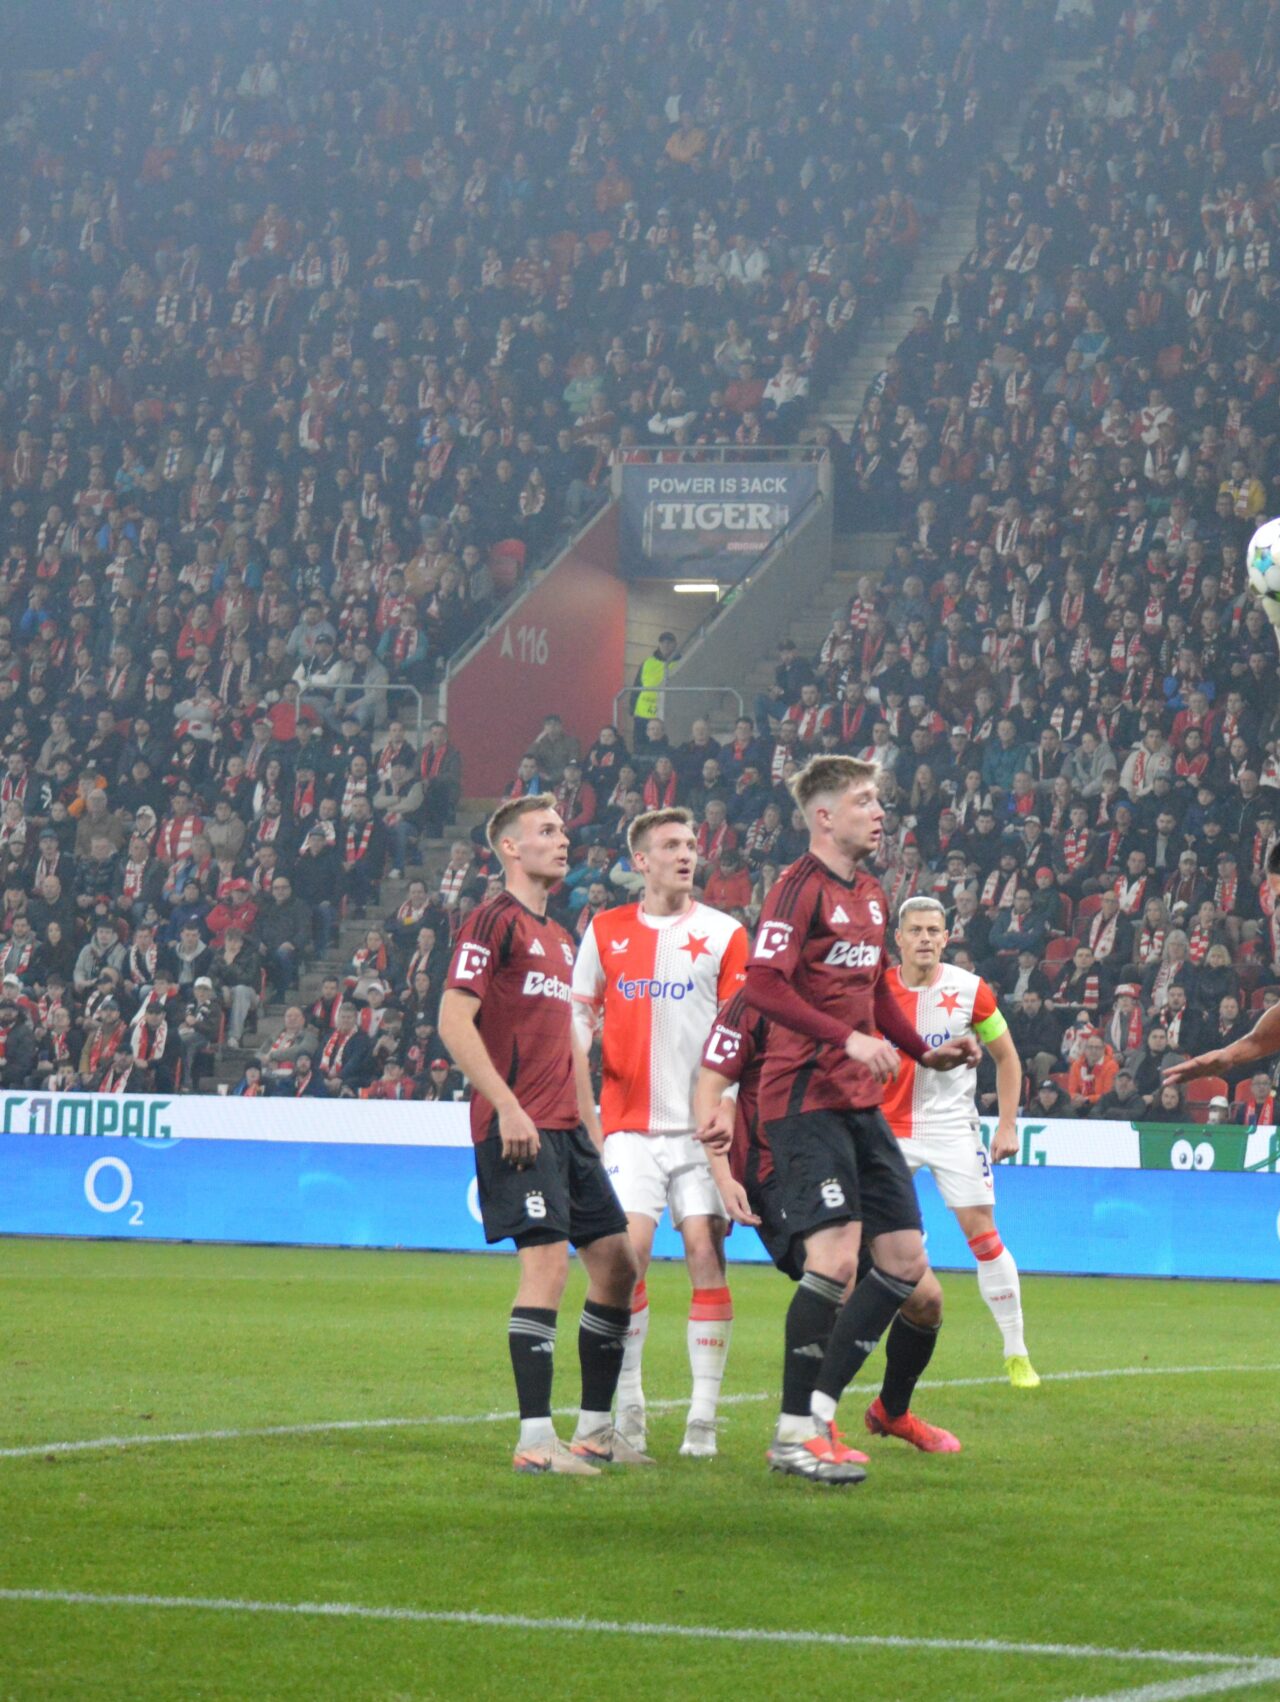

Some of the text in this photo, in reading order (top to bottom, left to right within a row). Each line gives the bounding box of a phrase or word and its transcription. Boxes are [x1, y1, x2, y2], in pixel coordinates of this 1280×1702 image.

[648, 478, 716, 494] POWER
[720, 478, 737, 494] IS
[657, 503, 772, 531] TIGER
